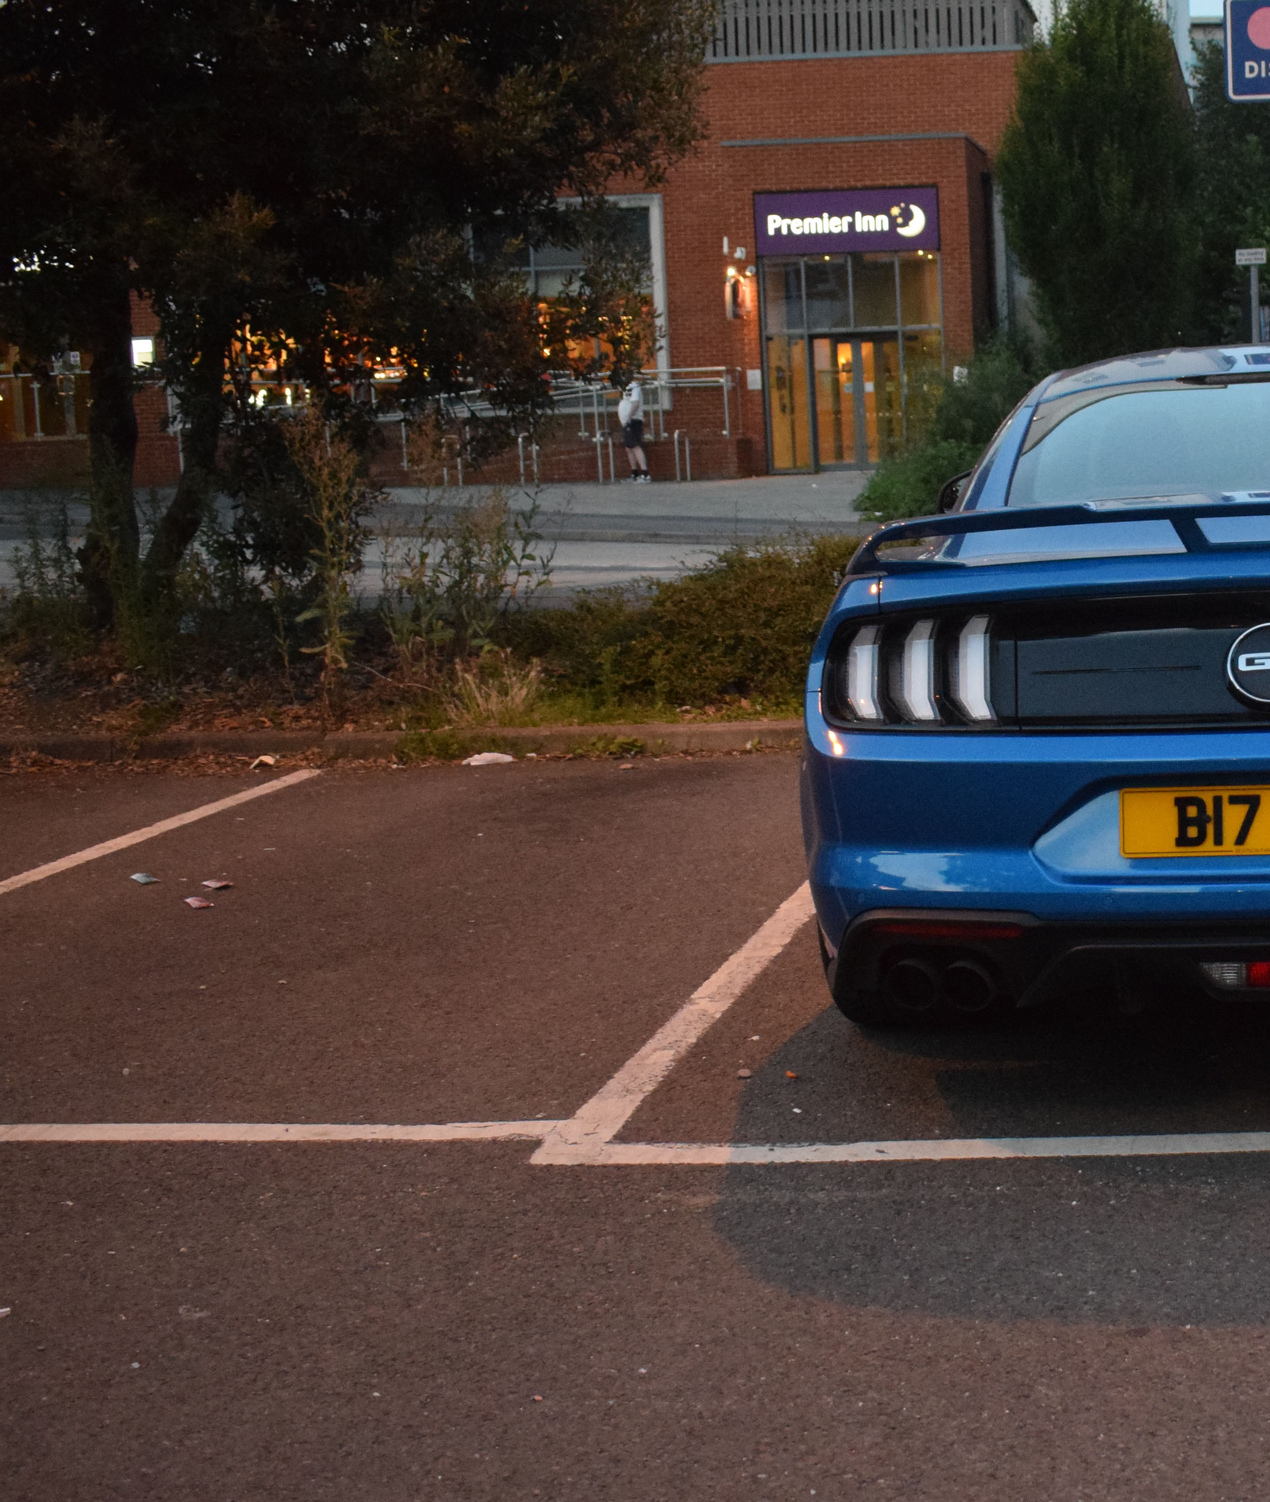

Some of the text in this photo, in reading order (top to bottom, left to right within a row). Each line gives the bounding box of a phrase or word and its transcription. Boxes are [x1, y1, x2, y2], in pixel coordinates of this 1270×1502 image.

[767, 211, 889, 236] Premier Inn
[1174, 794, 1261, 847] B17
